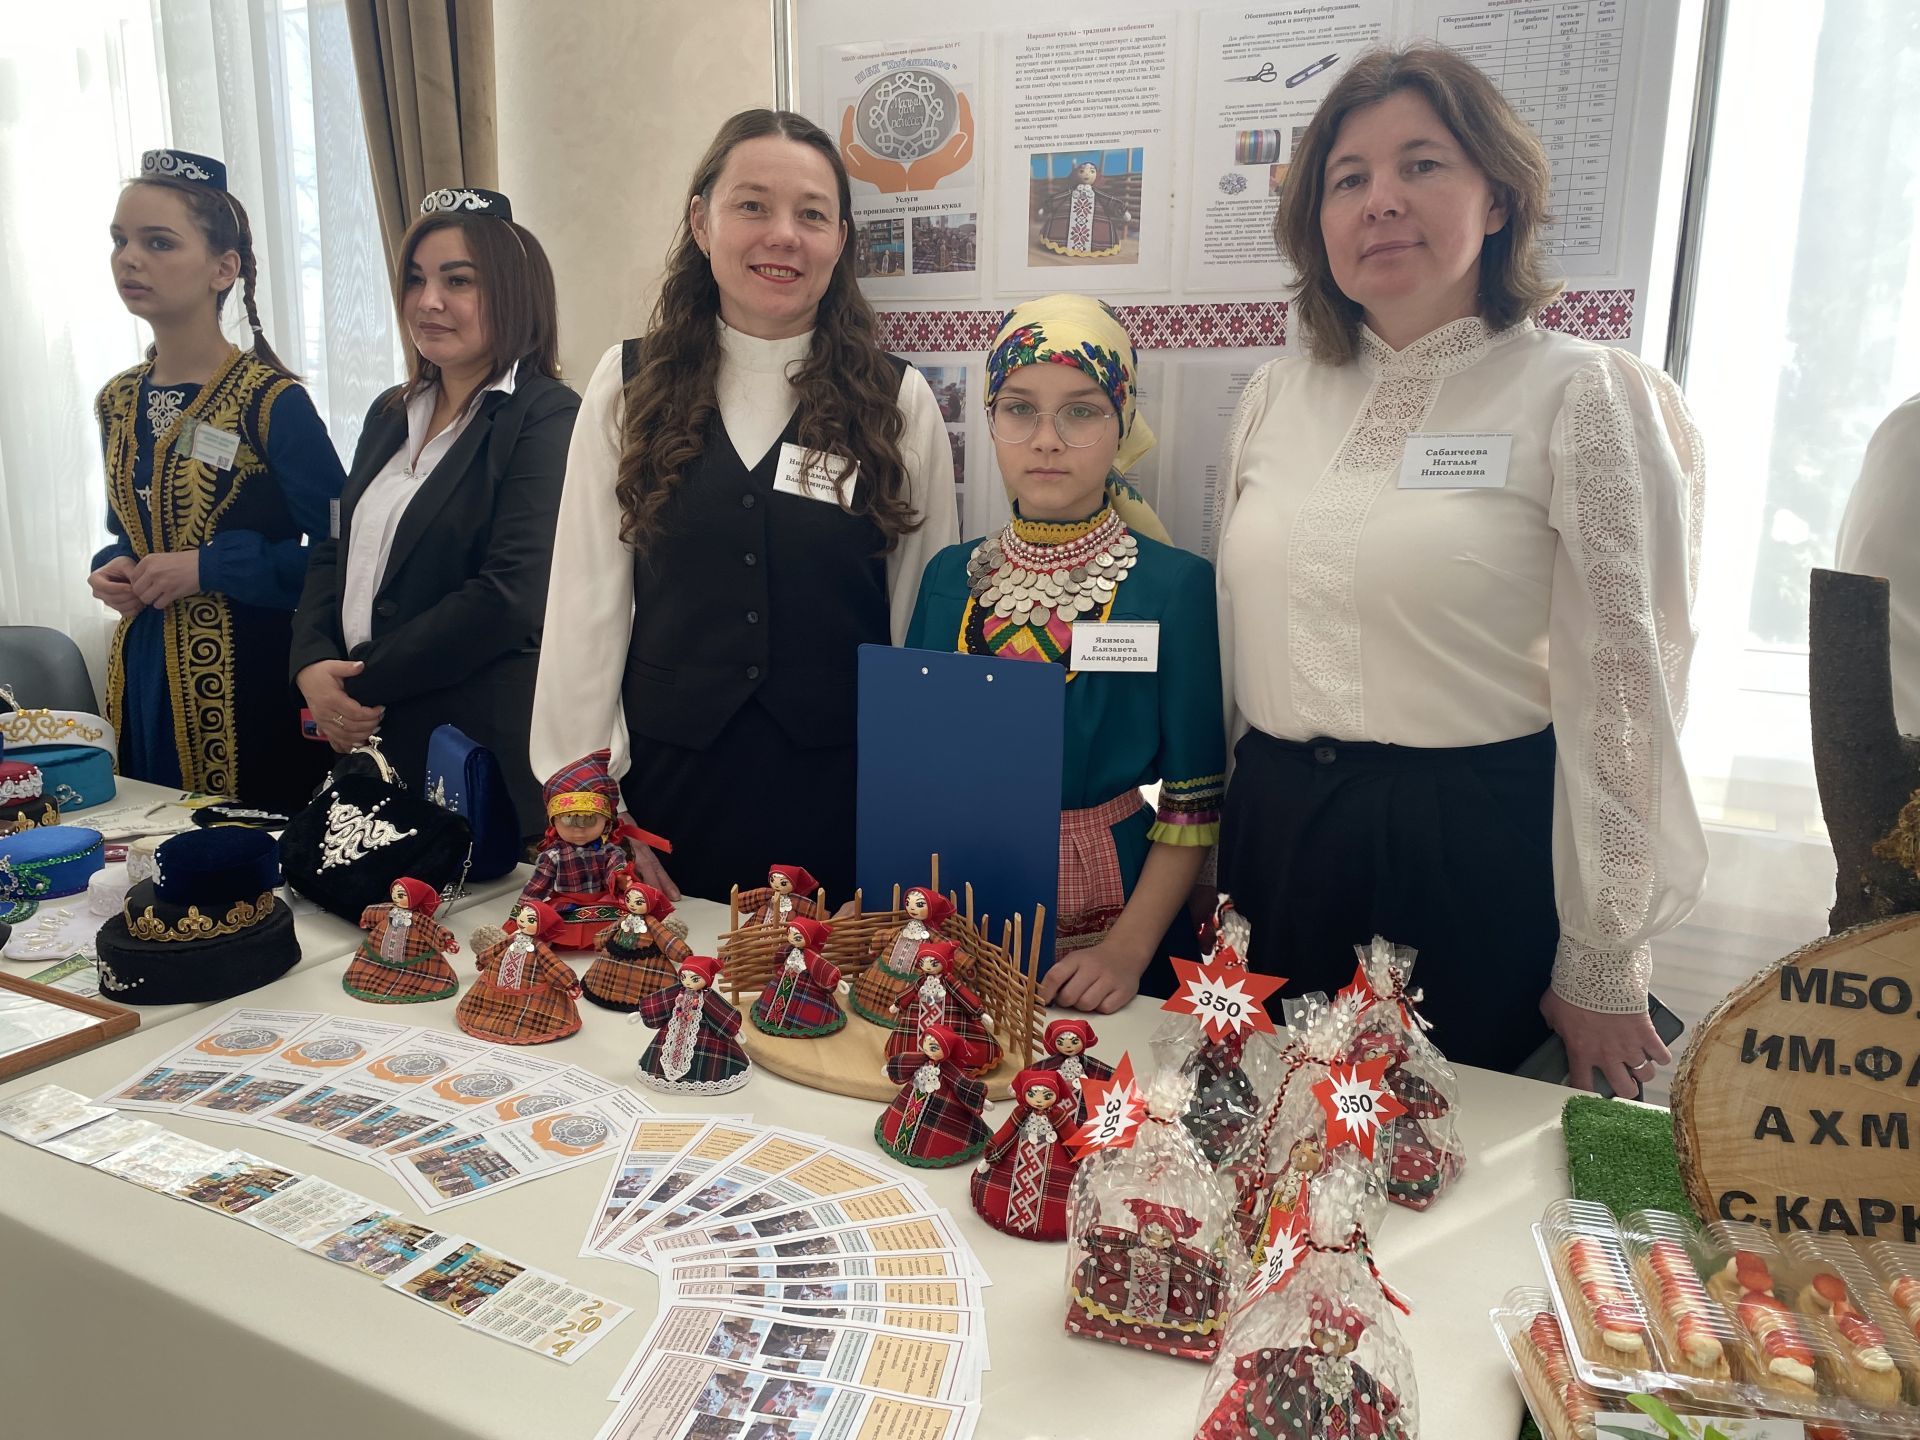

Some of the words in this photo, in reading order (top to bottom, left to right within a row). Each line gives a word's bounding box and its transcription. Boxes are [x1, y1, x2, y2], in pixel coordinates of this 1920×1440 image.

[864, 207, 906, 216] производству
[908, 204, 940, 213] народных
[941, 202, 962, 210] кукол
[1425, 448, 1488, 456] Сабанчеева
[1080, 654, 1148, 663] Александровна
[1198, 989, 1242, 1018] 350
[1780, 965, 1920, 1019] МБО
[1339, 1093, 1373, 1114] 350
[1100, 1098, 1121, 1139] 350
[1266, 1248, 1284, 1286] 350
